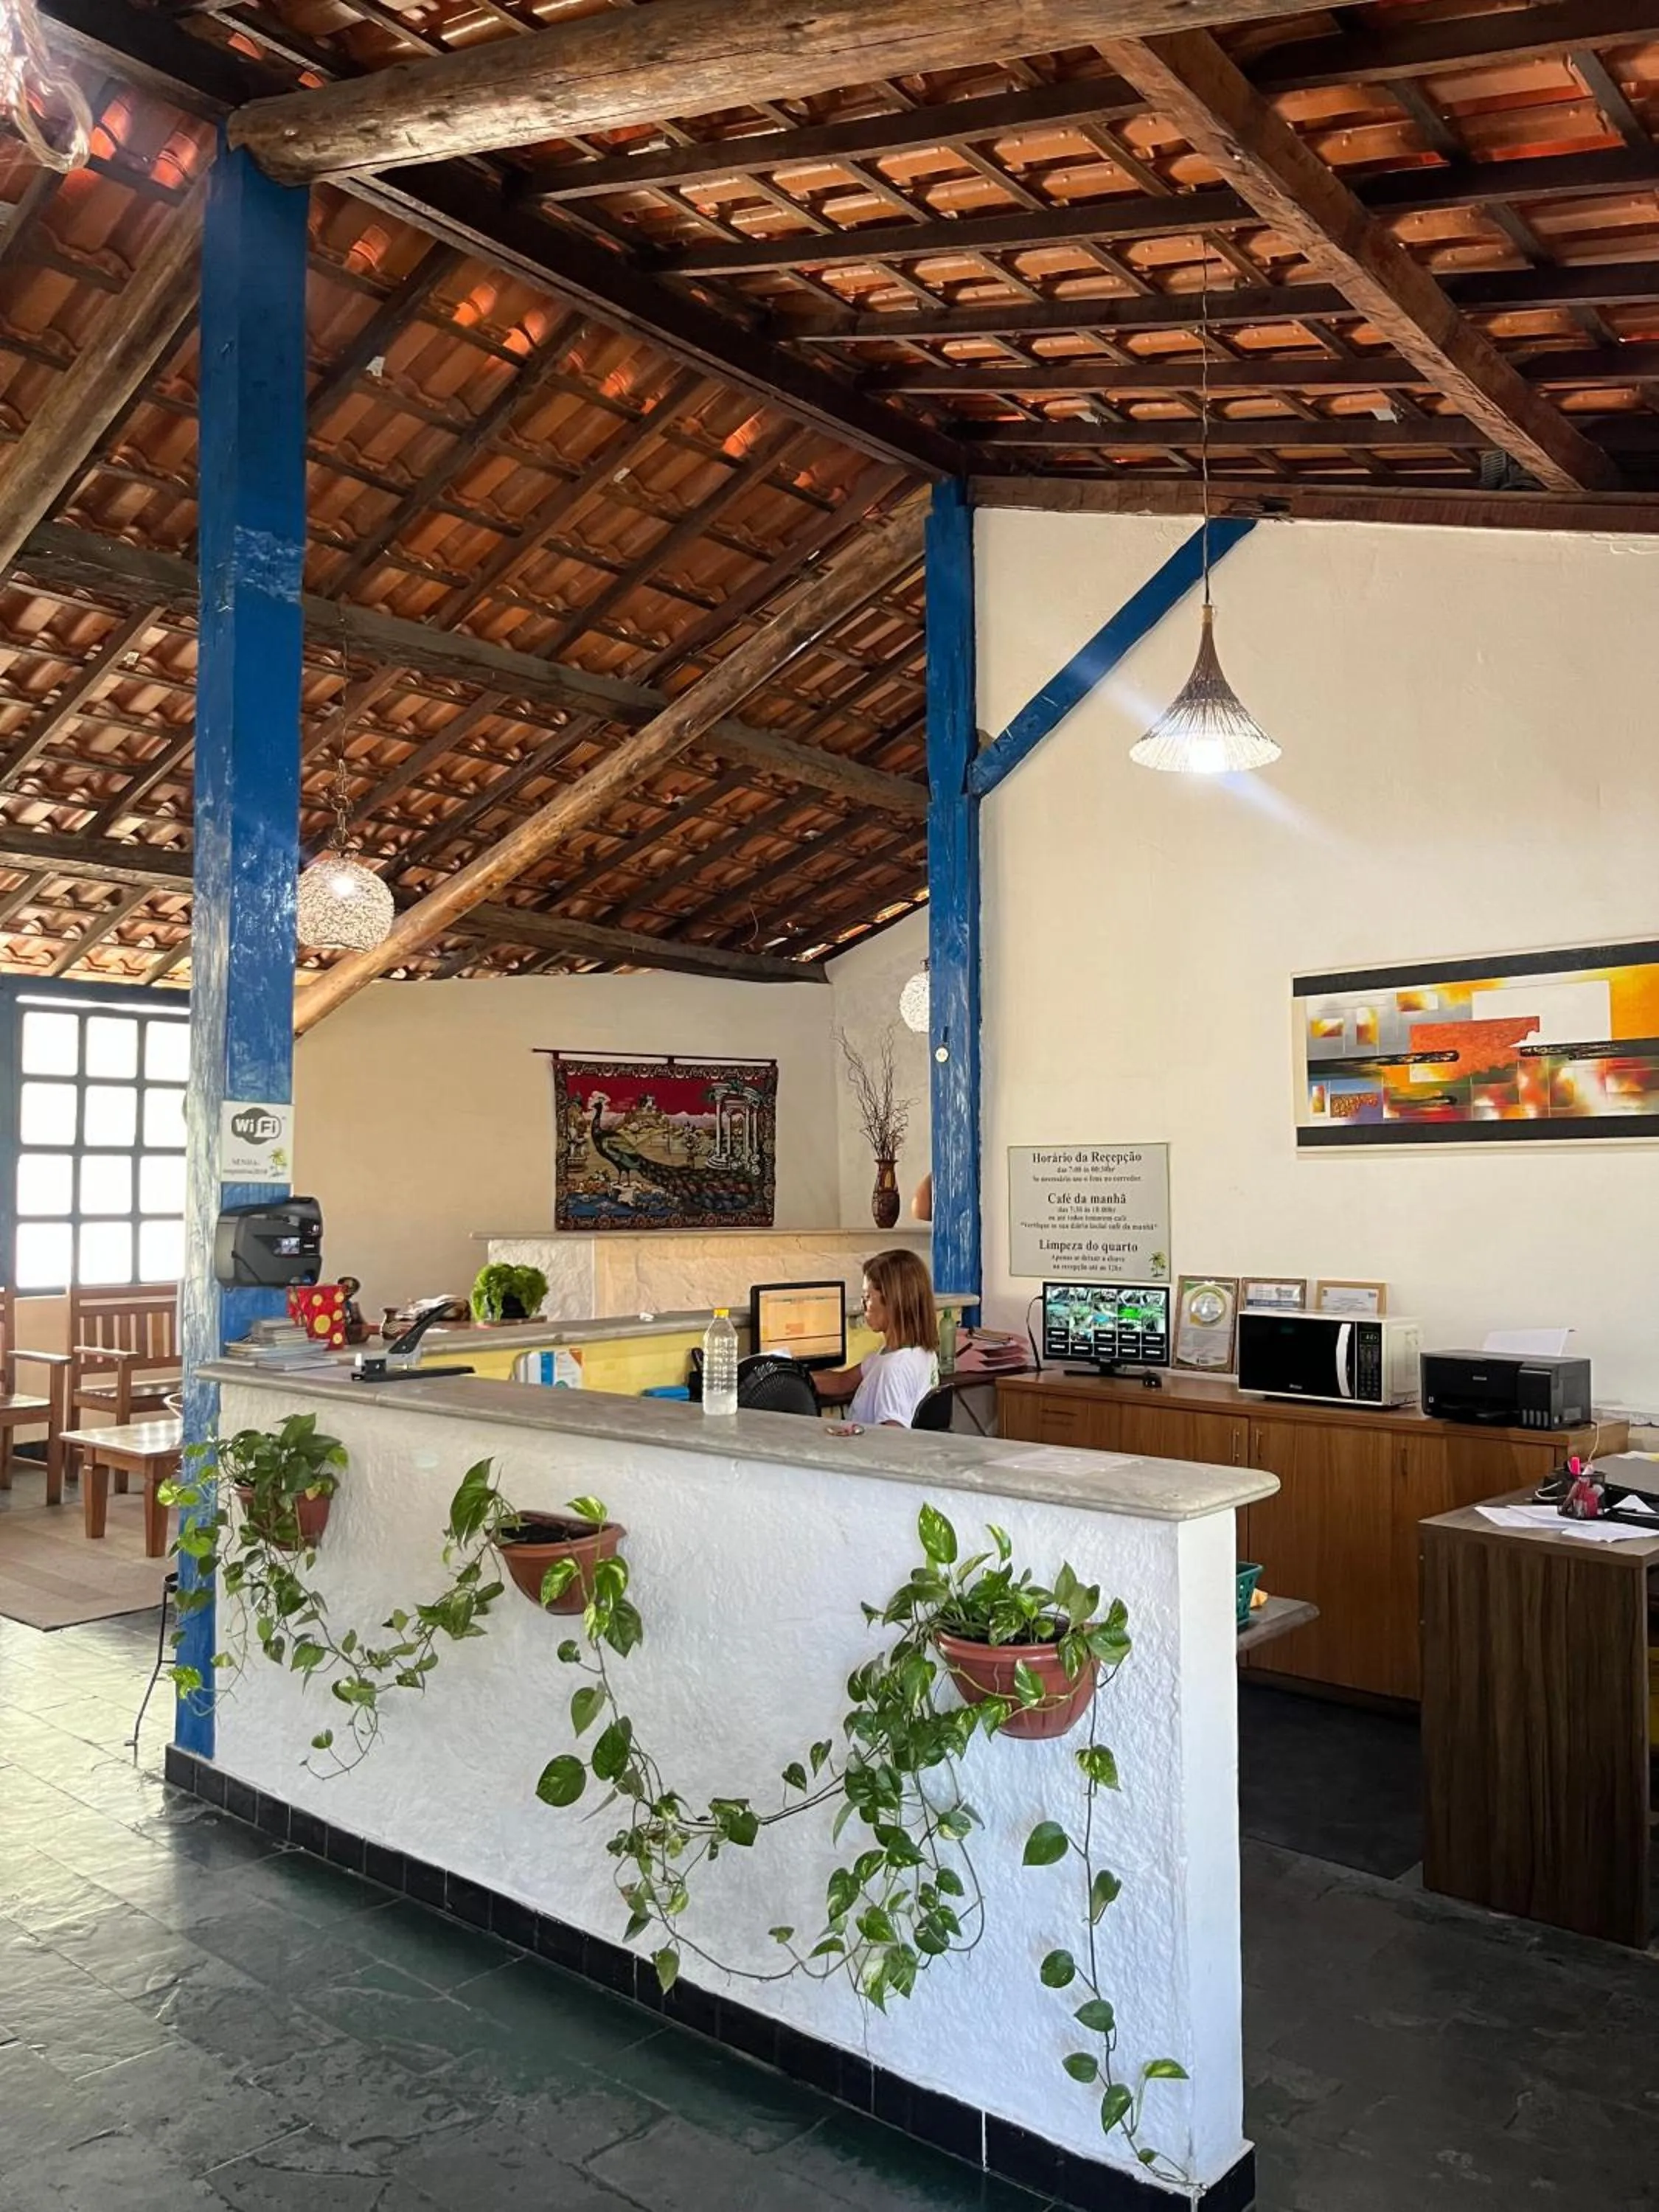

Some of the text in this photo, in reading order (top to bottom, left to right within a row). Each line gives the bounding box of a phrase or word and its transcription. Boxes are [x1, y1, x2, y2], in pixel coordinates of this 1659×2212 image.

[1032, 1152, 1073, 1163] Horário
[1075, 1152, 1088, 1163] da
[1048, 1192, 1127, 1204] Café da manhã
[1039, 1239, 1138, 1253] Limpeza do quarto
